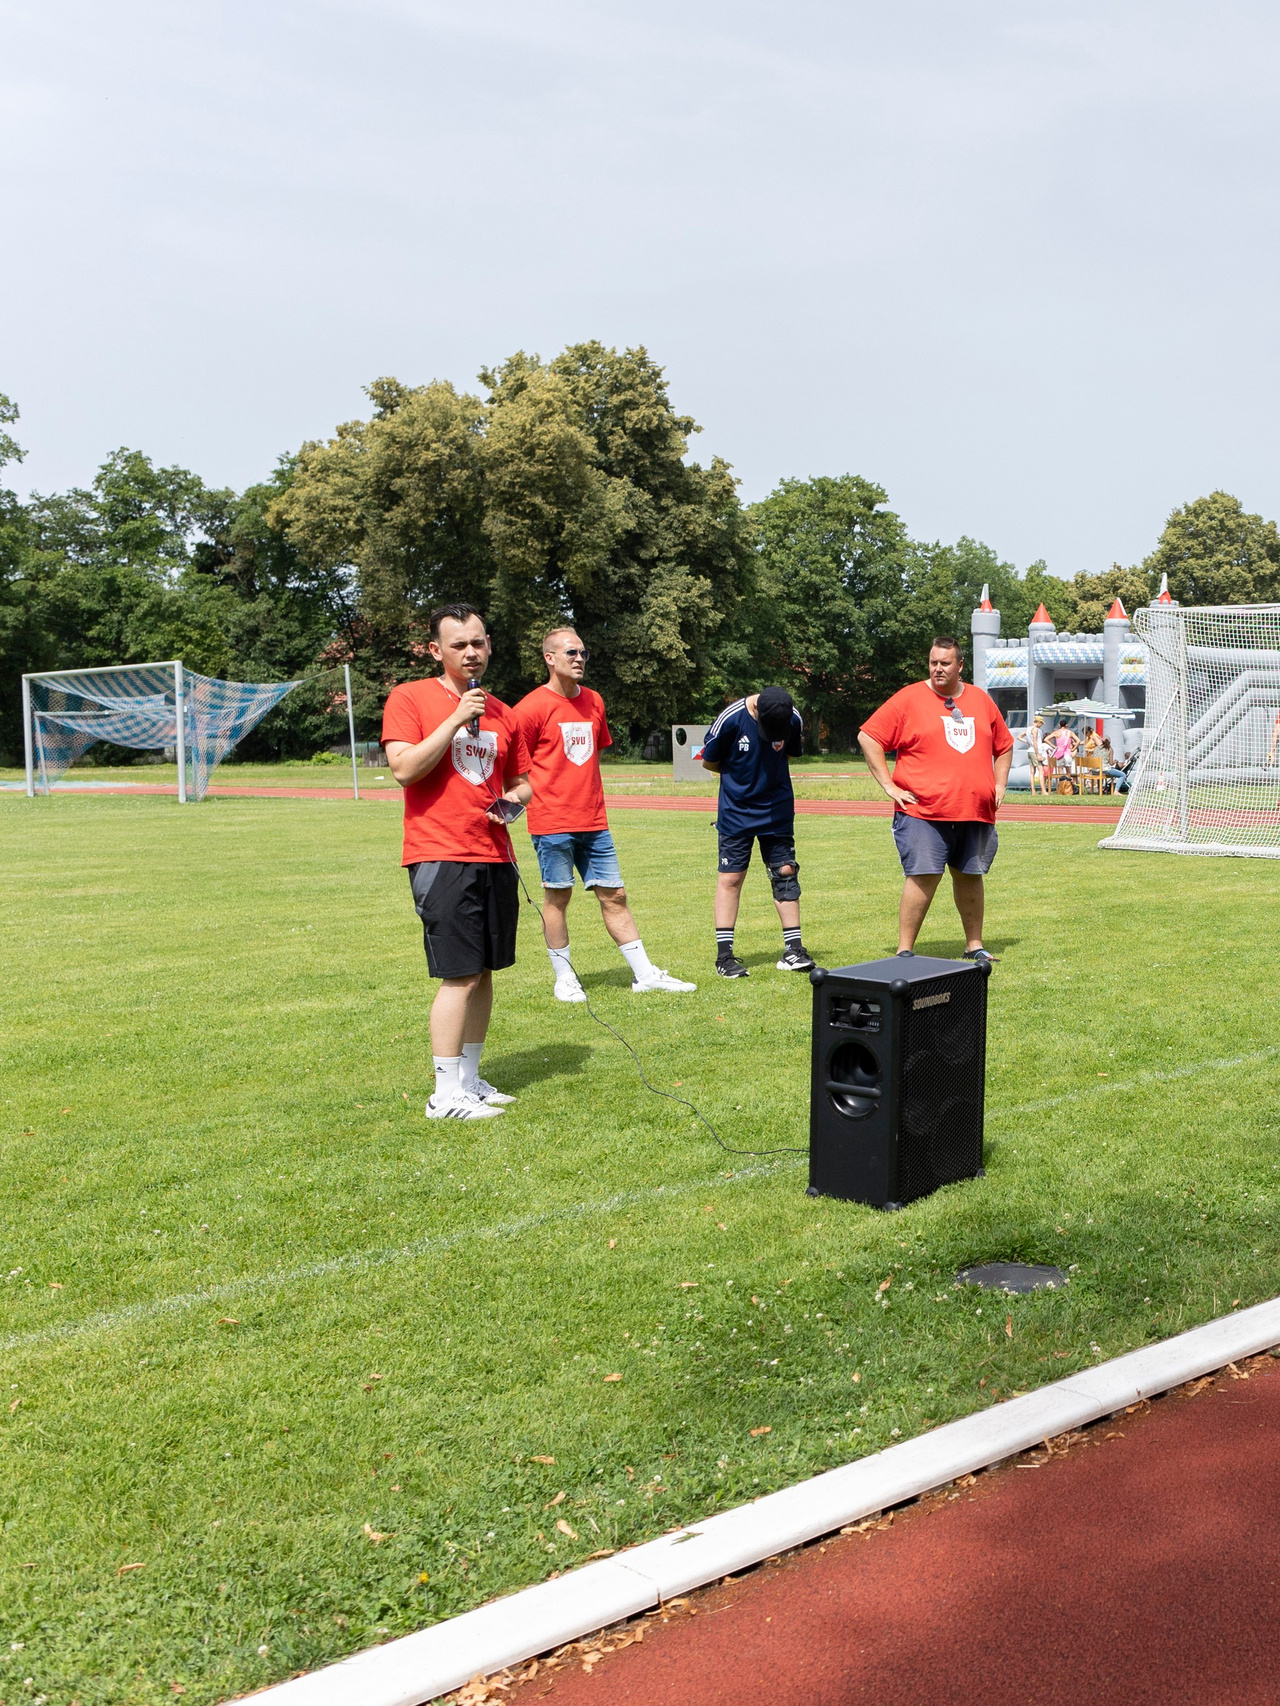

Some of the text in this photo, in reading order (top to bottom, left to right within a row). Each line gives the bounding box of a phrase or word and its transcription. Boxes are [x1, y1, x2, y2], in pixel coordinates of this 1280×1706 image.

[953, 728, 968, 736] SVU
[571, 736, 586, 746] SVU
[465, 744, 487, 759] SVU
[738, 743, 750, 752] PB
